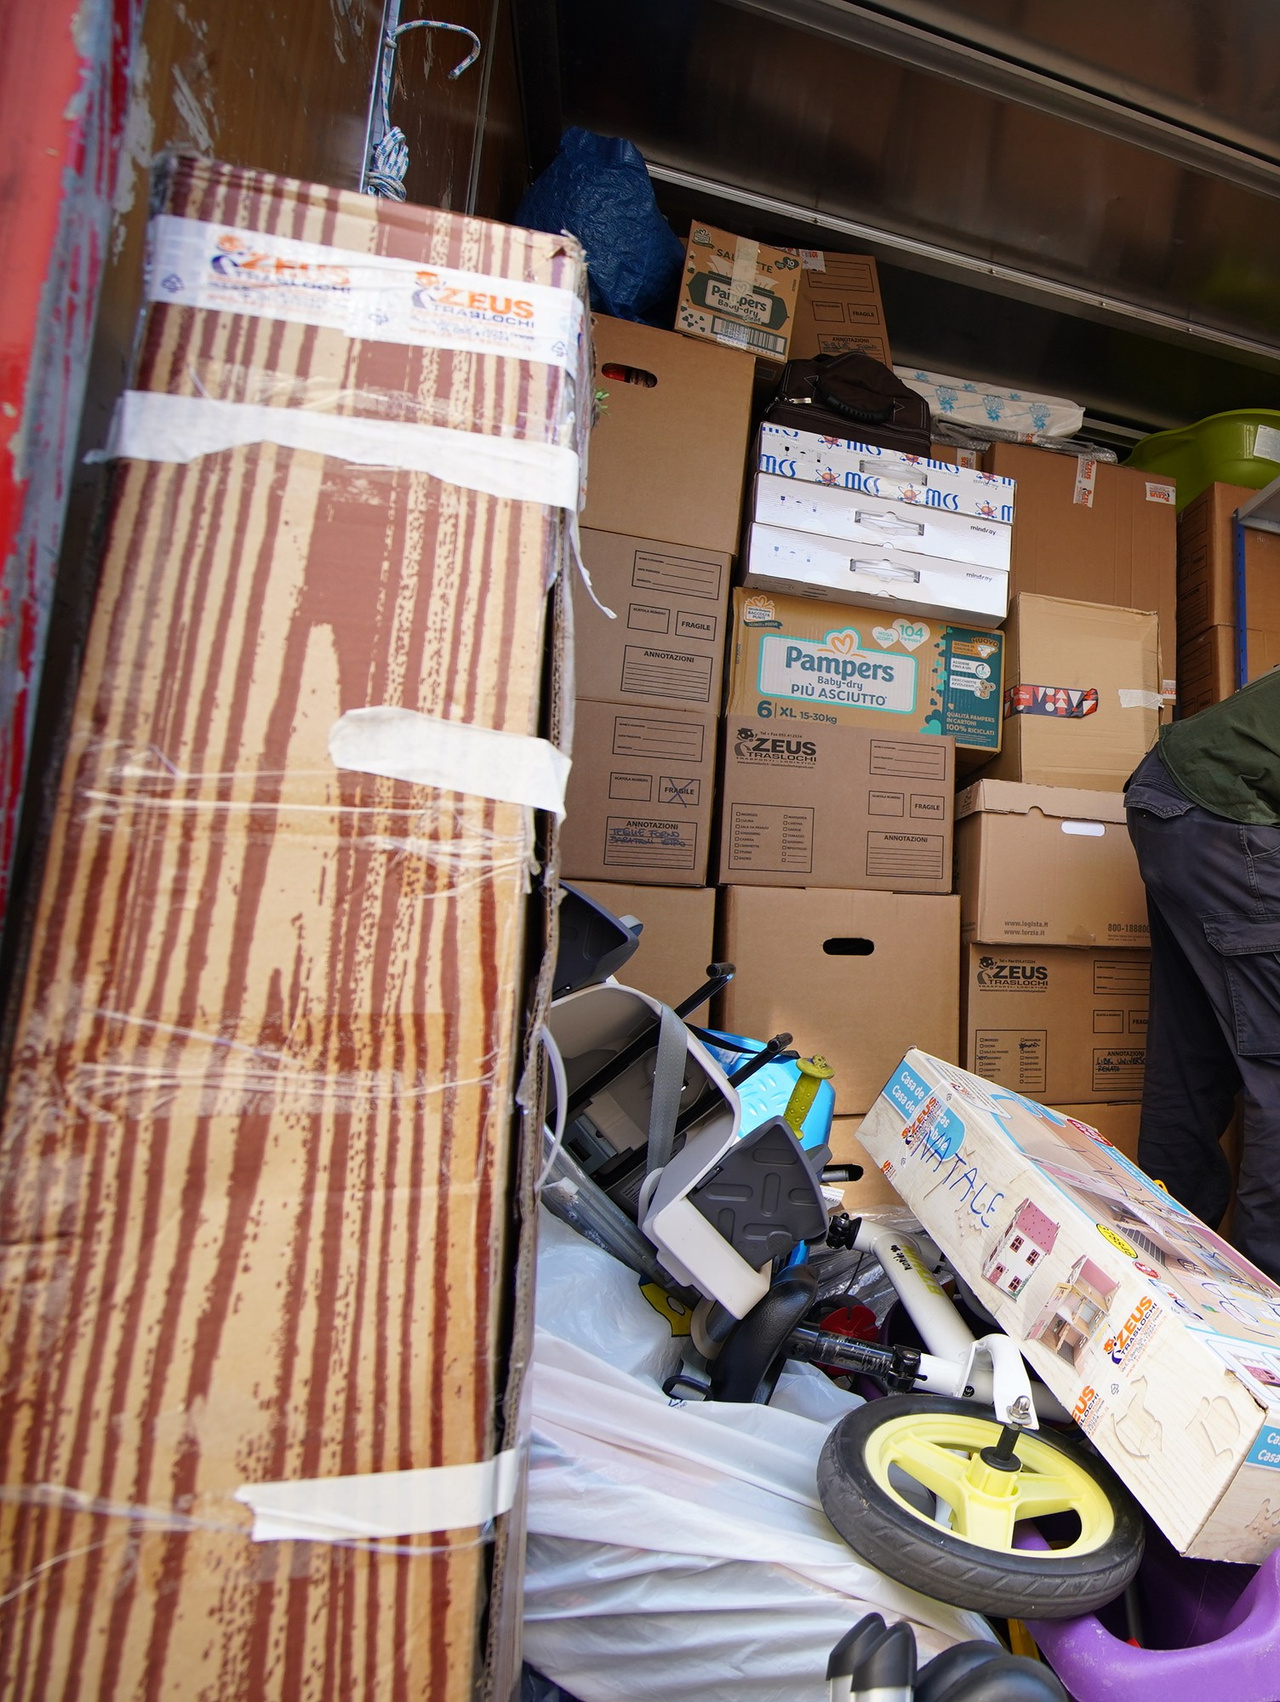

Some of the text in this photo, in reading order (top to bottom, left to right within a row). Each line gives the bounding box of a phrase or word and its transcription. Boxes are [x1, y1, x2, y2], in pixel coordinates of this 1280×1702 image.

[717, 248, 773, 273] SALTE
[436, 287, 535, 319] ZEUS
[432, 304, 535, 328] TRASLOCHI
[852, 310, 875, 318] FRAGILE
[970, 525, 997, 536] mindray
[966, 572, 993, 583] mindray
[681, 620, 711, 631] FRAGILE
[899, 624, 924, 639] 104
[971, 637, 999, 648] NUOVO
[643, 650, 695, 663] ANNOTAZIONI
[785, 646, 894, 682] Pampers
[791, 682, 815, 697] PIÙ
[817, 675, 863, 691] Baby-dry
[757, 700, 838, 724] 6 XL 15-30kg
[946, 711, 970, 719] QUALITÀ
[946, 724, 967, 732] 100%
[752, 737, 817, 756] ZEUS
[746, 751, 817, 762] TRASLOCHI
[664, 786, 695, 795] FRAGILE
[914, 803, 940, 811] FRAGILE
[626, 820, 679, 830] ANNOTAZIONI
[884, 834, 928, 843] ANNOTAZIONI
[1004, 920, 1049, 928] www.logista.it
[1004, 929, 1046, 937] www.terzia.it
[992, 965, 1049, 981] ZEUS
[901, 1071, 925, 1099] Casa de
[892, 1084, 908, 1108] Casa
[911, 1096, 937, 1134] ZEUS
[910, 1130, 1004, 1228] NATALE
[1115, 1296, 1153, 1348] ZEUS
[1121, 1302, 1158, 1355] TRASLOCHI
[1072, 1385, 1096, 1422] EUS
[1079, 1392, 1100, 1428] SLOCHI
[1257, 1449, 1280, 1463] Casa
